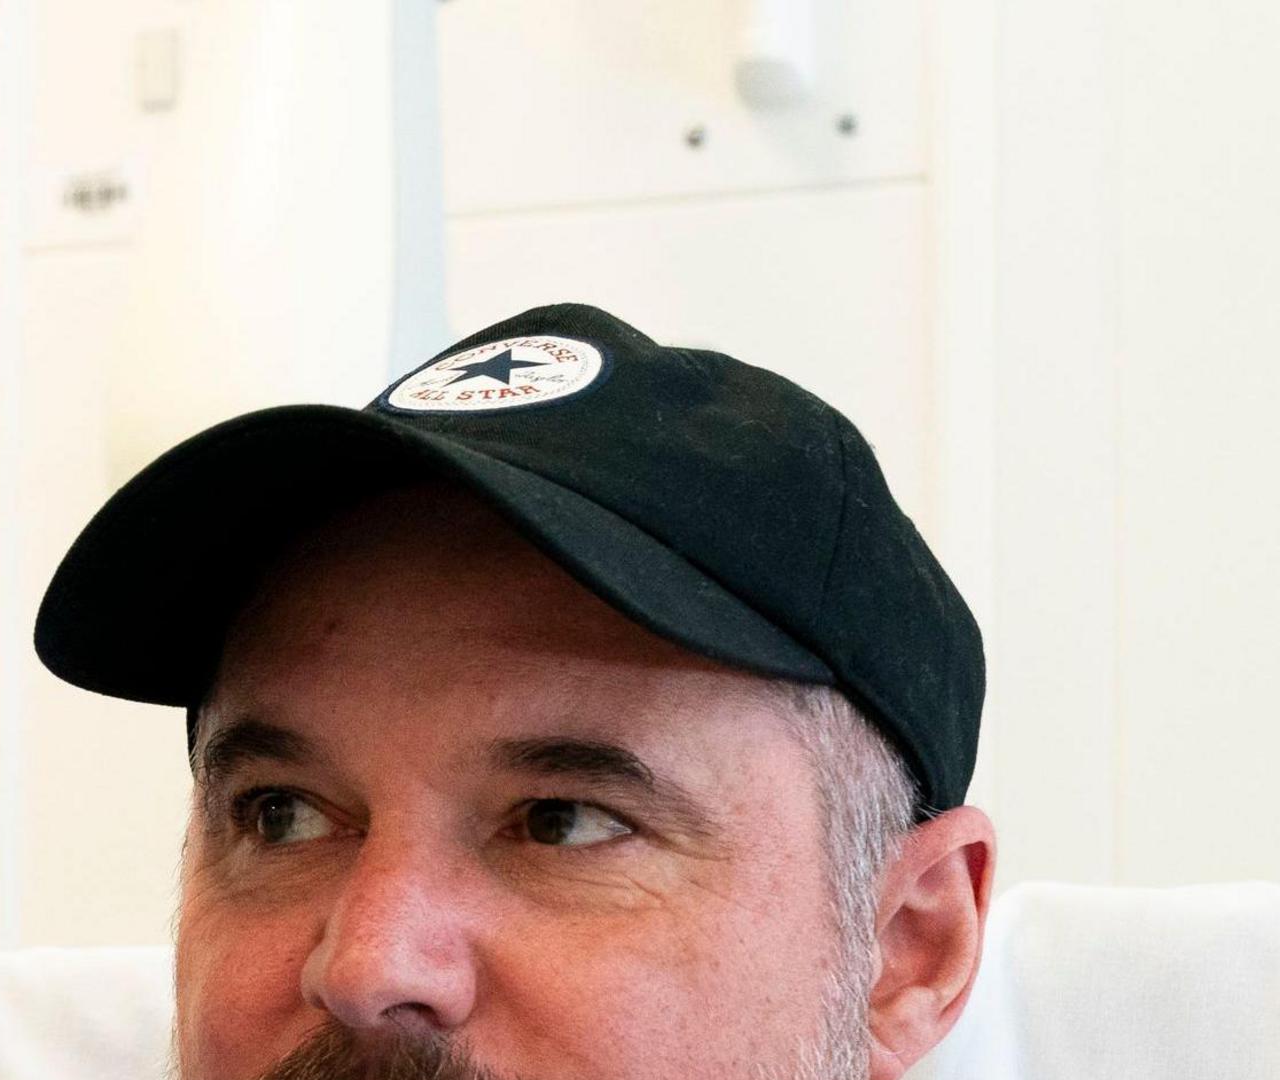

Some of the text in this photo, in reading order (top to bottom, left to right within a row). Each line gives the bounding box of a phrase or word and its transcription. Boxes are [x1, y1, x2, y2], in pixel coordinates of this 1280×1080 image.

[435, 340, 579, 371] CONVERSE
[409, 385, 540, 401] ALL STAR
